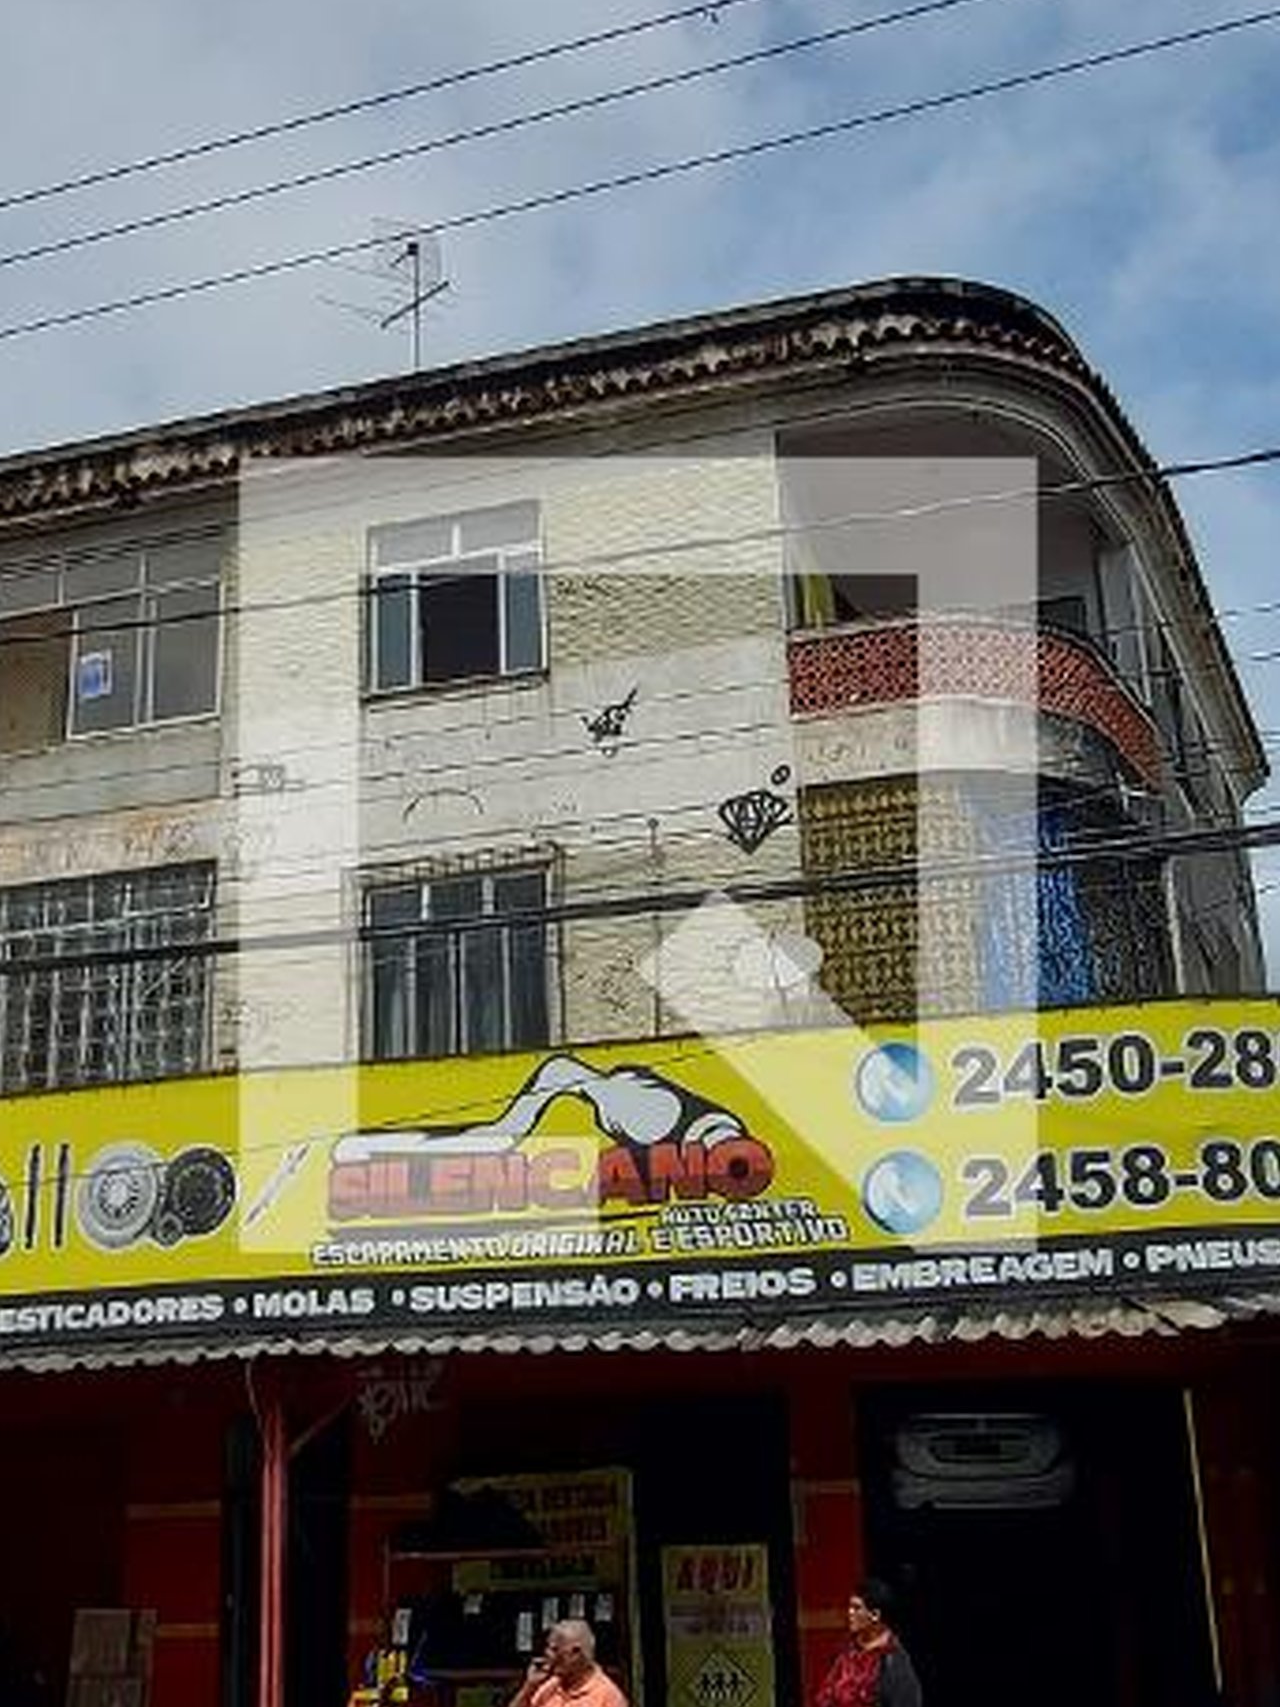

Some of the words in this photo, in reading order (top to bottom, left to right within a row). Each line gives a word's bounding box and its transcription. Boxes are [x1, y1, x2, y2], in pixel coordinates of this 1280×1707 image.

[328, 1137, 775, 1219] SILENCANO
[506, 1230, 639, 1260] ORIGINAL
[651, 1227, 673, 1251] E
[676, 1216, 850, 1250] ESPORTIVO
[254, 1287, 375, 1318] MOLAS
[670, 1267, 817, 1304] FREIOS
[852, 1248, 1114, 1291] EMBREAGEM
